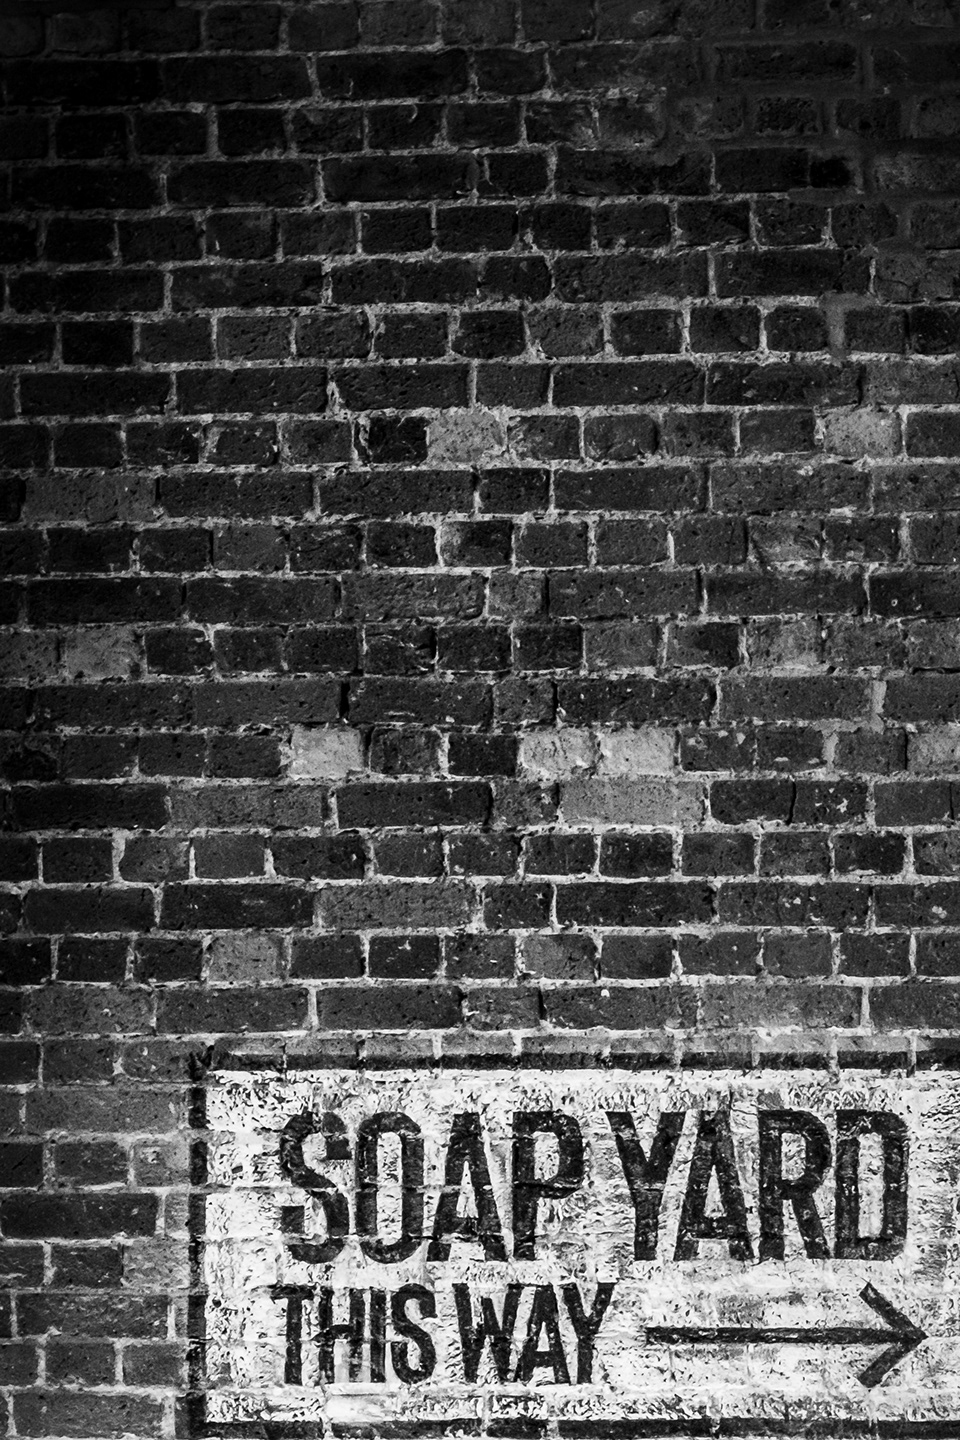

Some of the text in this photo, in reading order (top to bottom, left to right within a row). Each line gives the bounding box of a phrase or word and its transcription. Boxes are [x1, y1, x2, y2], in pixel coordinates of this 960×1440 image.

[278, 1107, 910, 1264] SOAP YARD
[268, 1280, 617, 1386] THIS WAY
